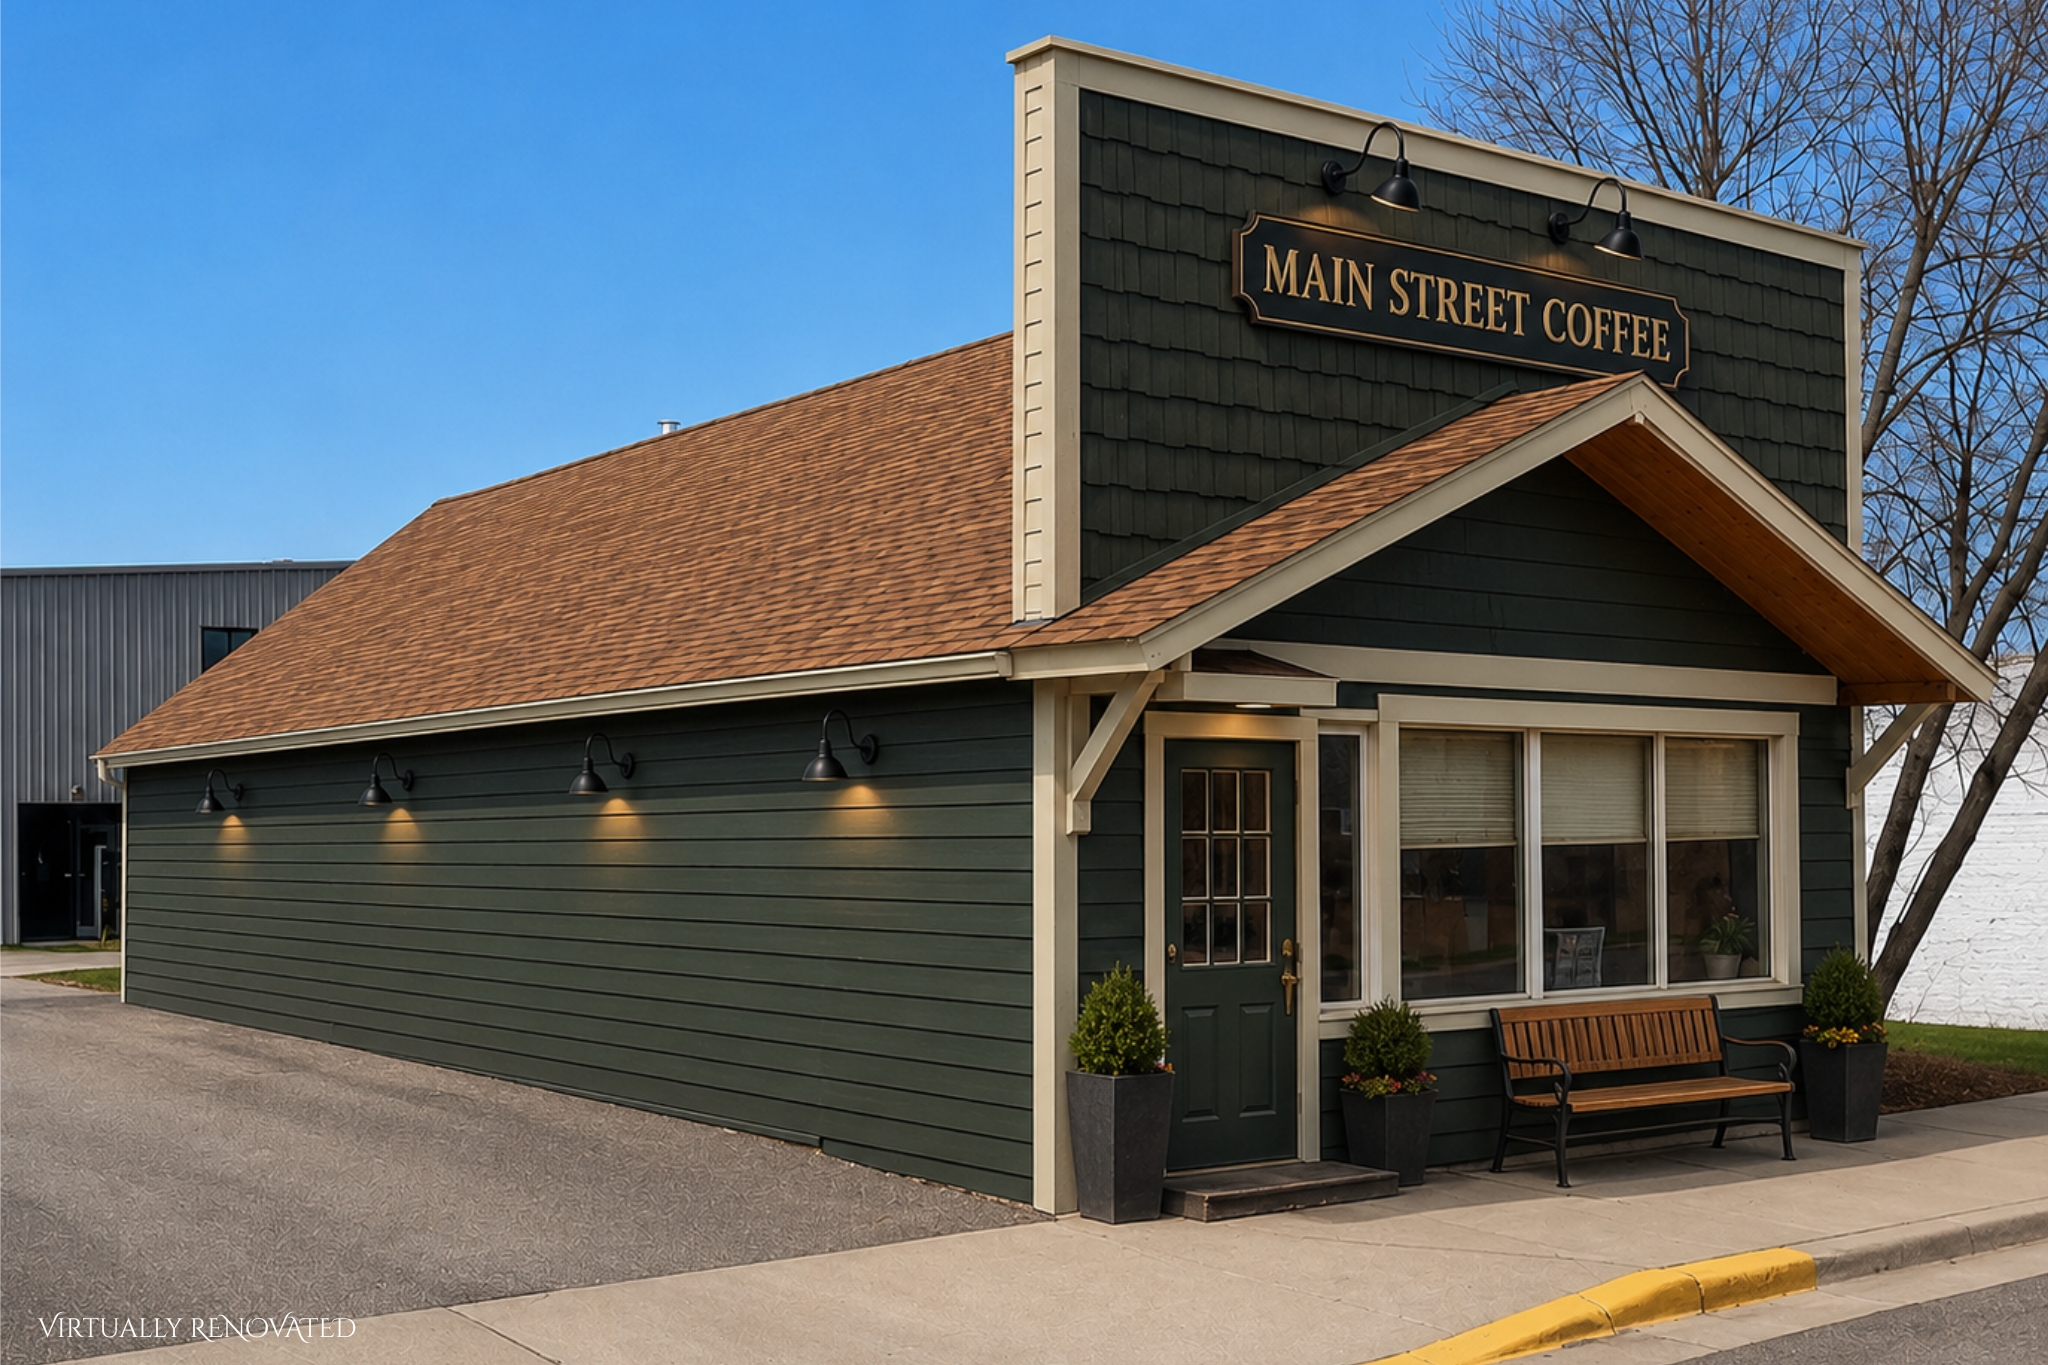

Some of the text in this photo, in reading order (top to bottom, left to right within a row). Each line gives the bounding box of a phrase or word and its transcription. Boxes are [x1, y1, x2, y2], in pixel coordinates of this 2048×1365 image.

[1263, 244, 1671, 362] MAIN STREET COFFEE
